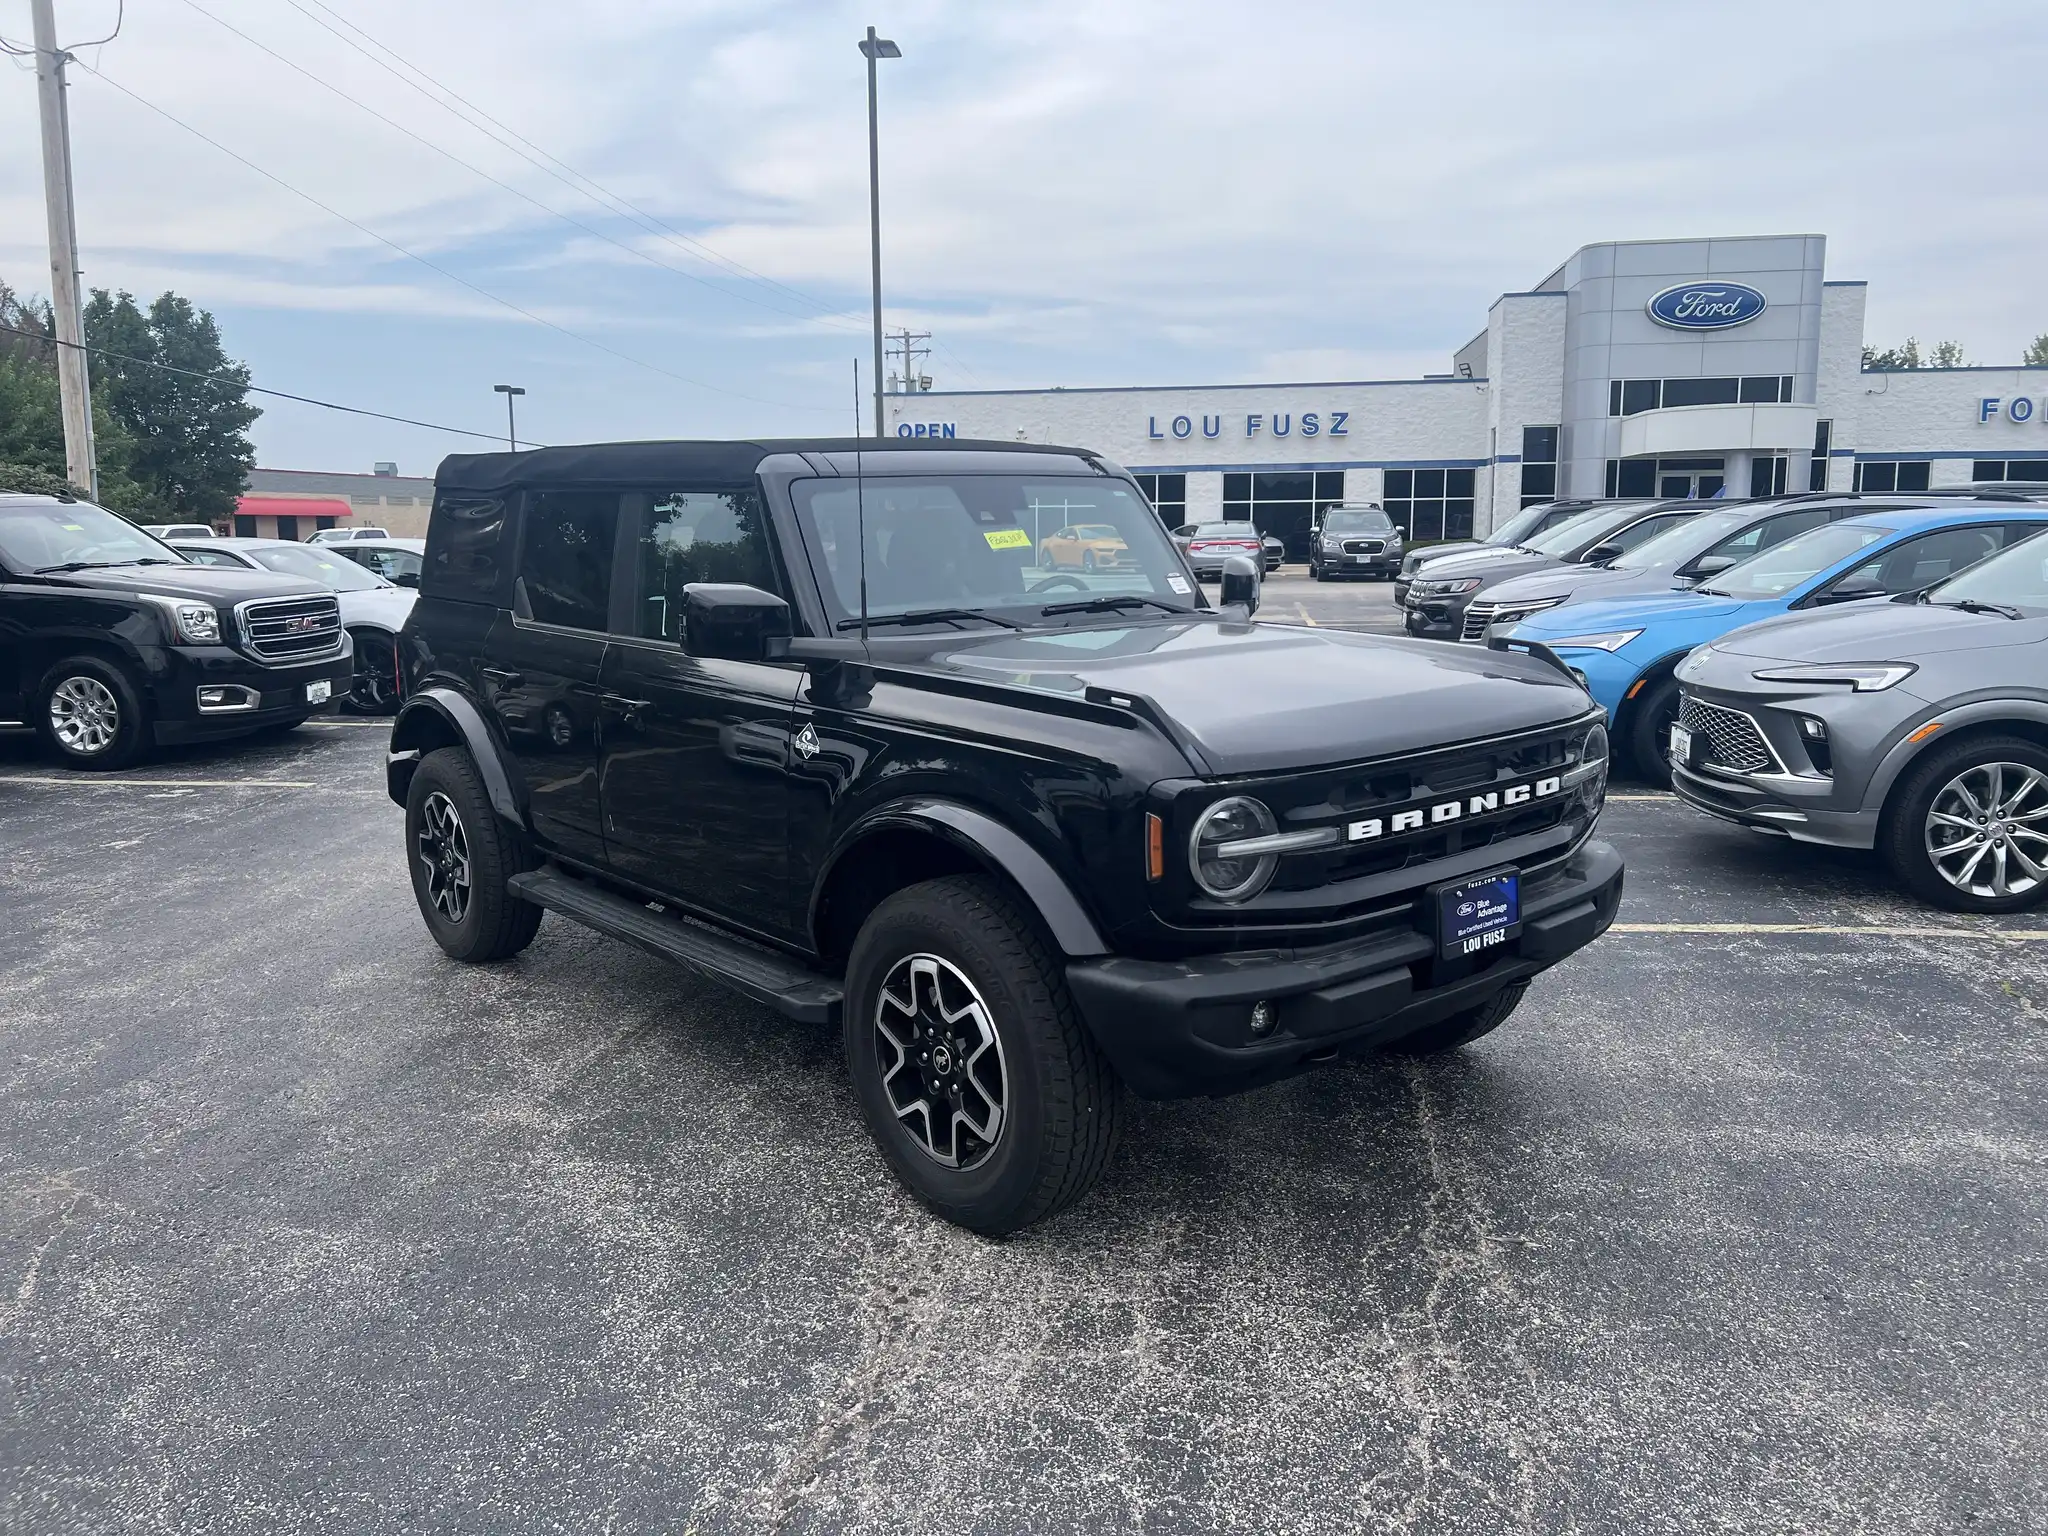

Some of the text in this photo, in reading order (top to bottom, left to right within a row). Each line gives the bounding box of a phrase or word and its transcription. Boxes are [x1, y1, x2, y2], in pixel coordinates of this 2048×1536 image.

[1675, 291, 1743, 318] Ford
[1980, 396, 2048, 423] FO
[897, 422, 956, 439] OPEN
[1149, 412, 1350, 440] LOU FUSZ
[286, 616, 321, 632] GMC
[1348, 776, 1560, 841] BRONCO
[1477, 900, 1490, 909] Blue
[1477, 904, 1508, 918] Advantage
[1463, 928, 1505, 953] LOU FUSZ
